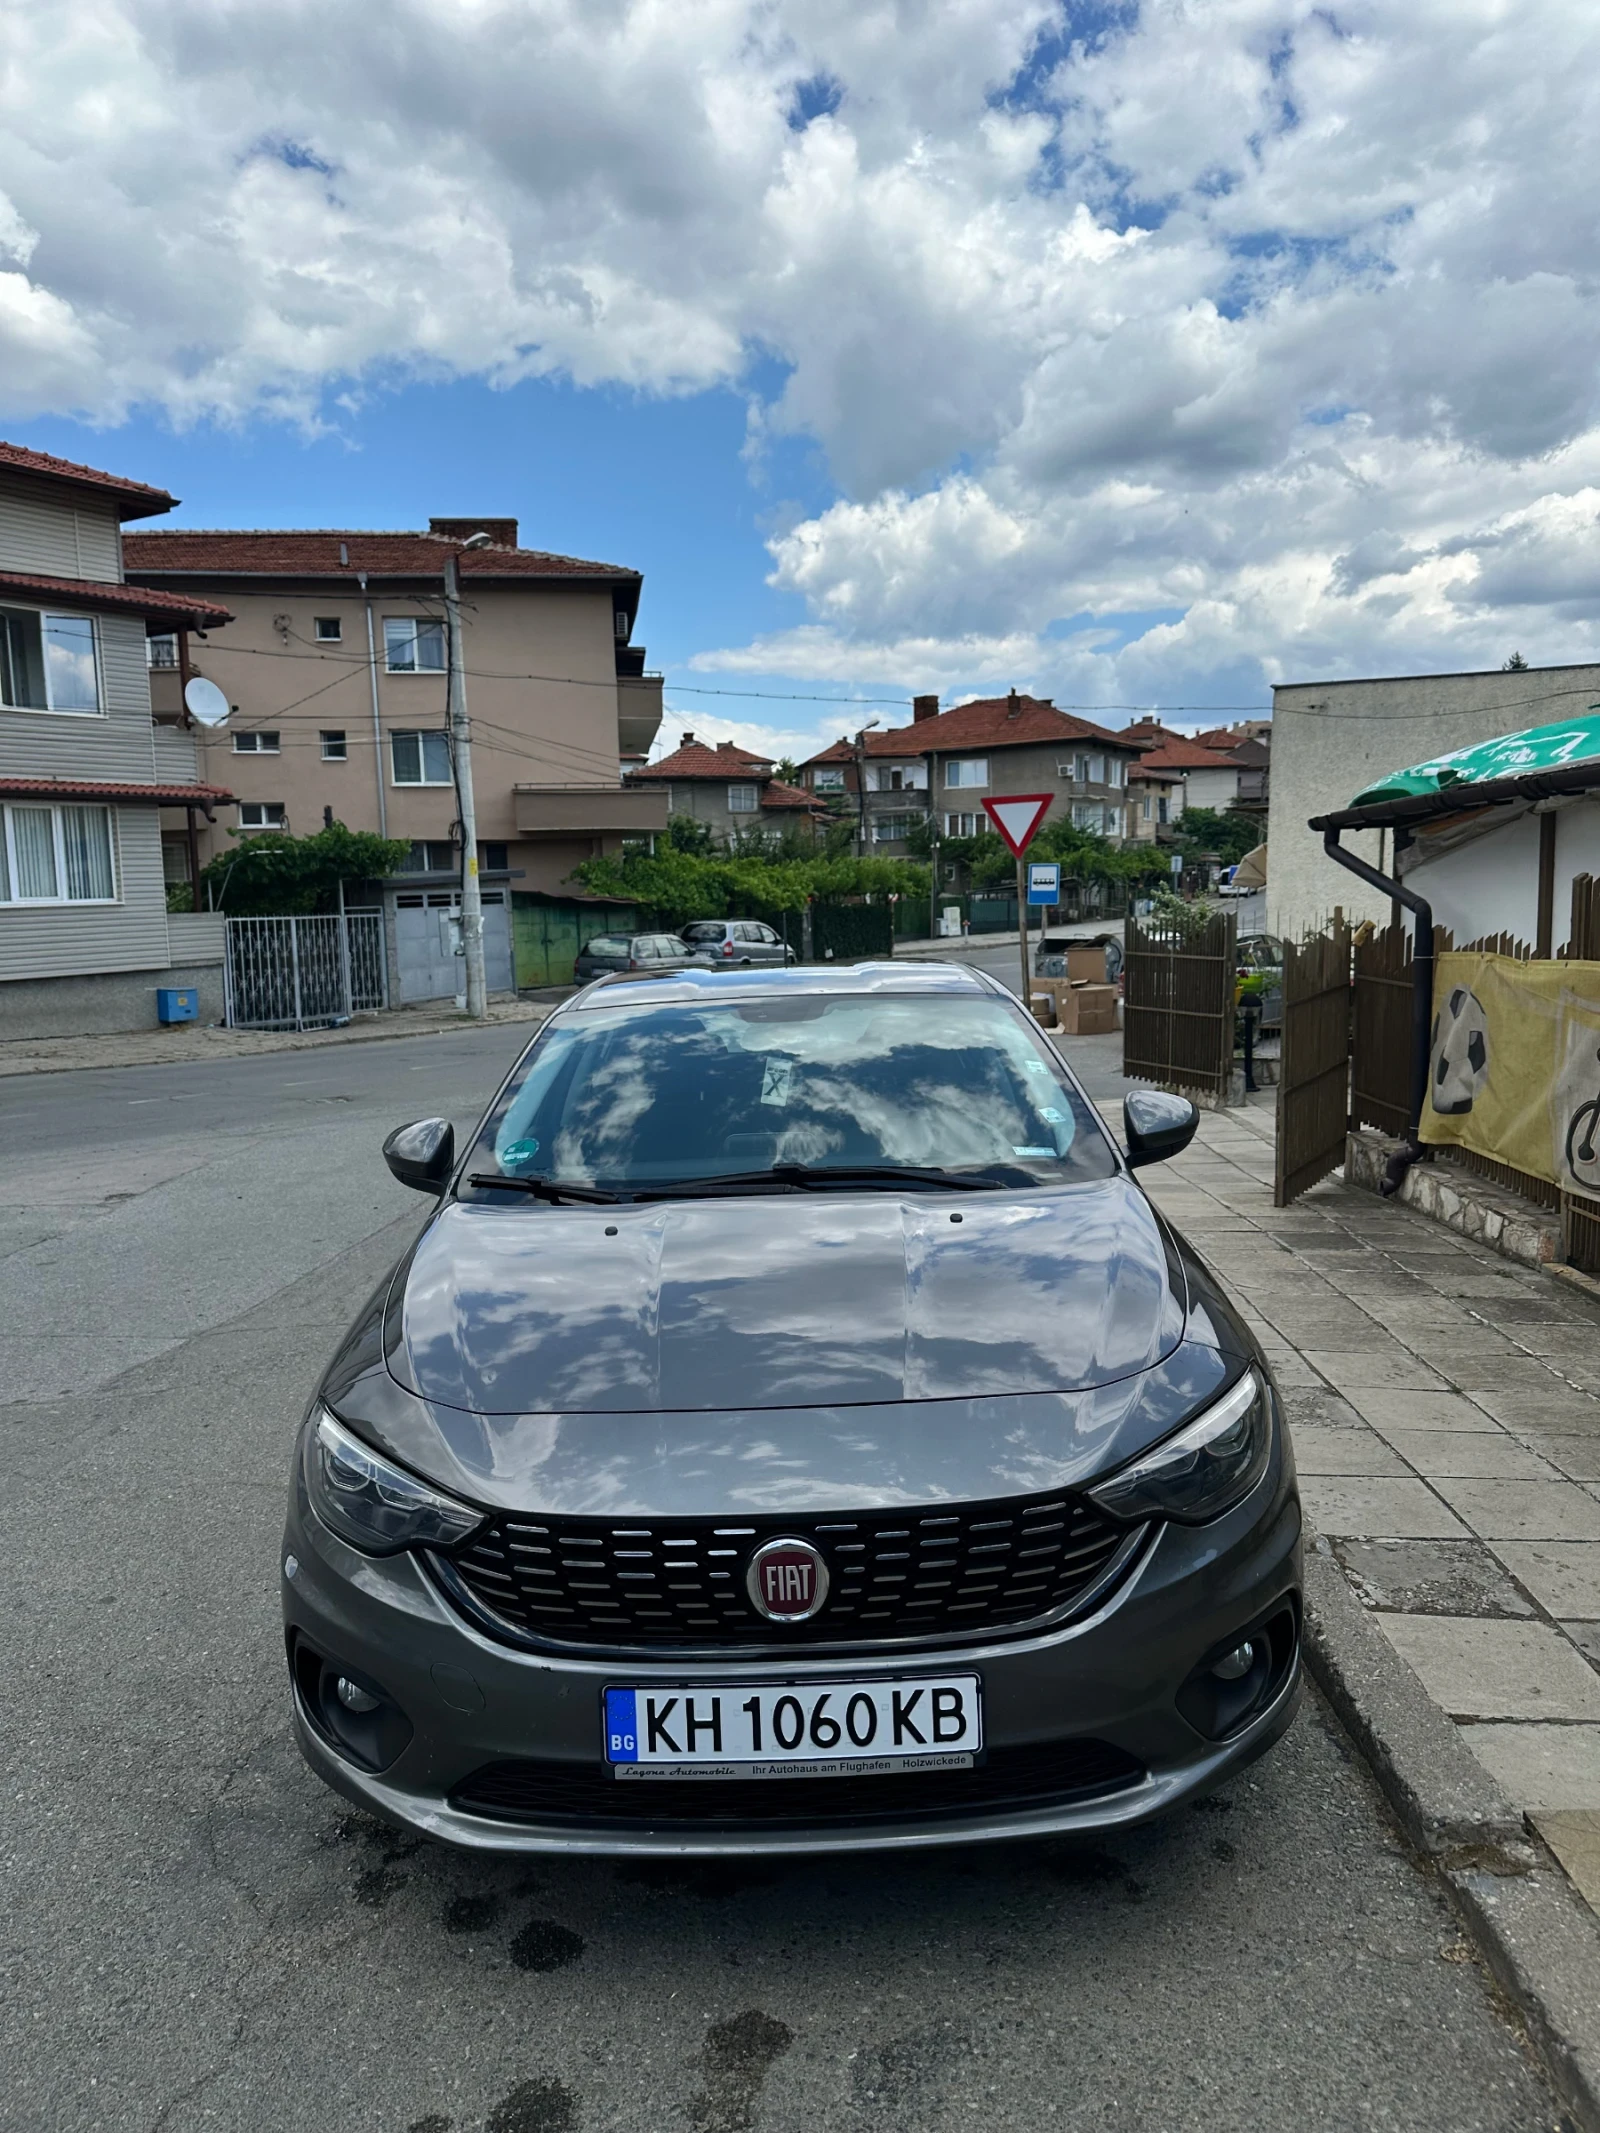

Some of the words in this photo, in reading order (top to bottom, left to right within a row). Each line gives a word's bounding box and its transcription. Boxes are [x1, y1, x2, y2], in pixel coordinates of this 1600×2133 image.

[766, 1564, 812, 1601] FIAT
[646, 1697, 722, 1752] KH
[743, 1691, 878, 1751] 1060
[892, 1686, 967, 1746] KB
[611, 1734, 635, 1751] BG
[669, 1766, 736, 1776] Automobile
[752, 1765, 767, 1775] Ihr
[768, 1765, 818, 1774] Autohaus
[820, 1764, 837, 1772] am
[839, 1760, 891, 1773] Flughafen
[902, 1756, 967, 1769] Holzwickede
